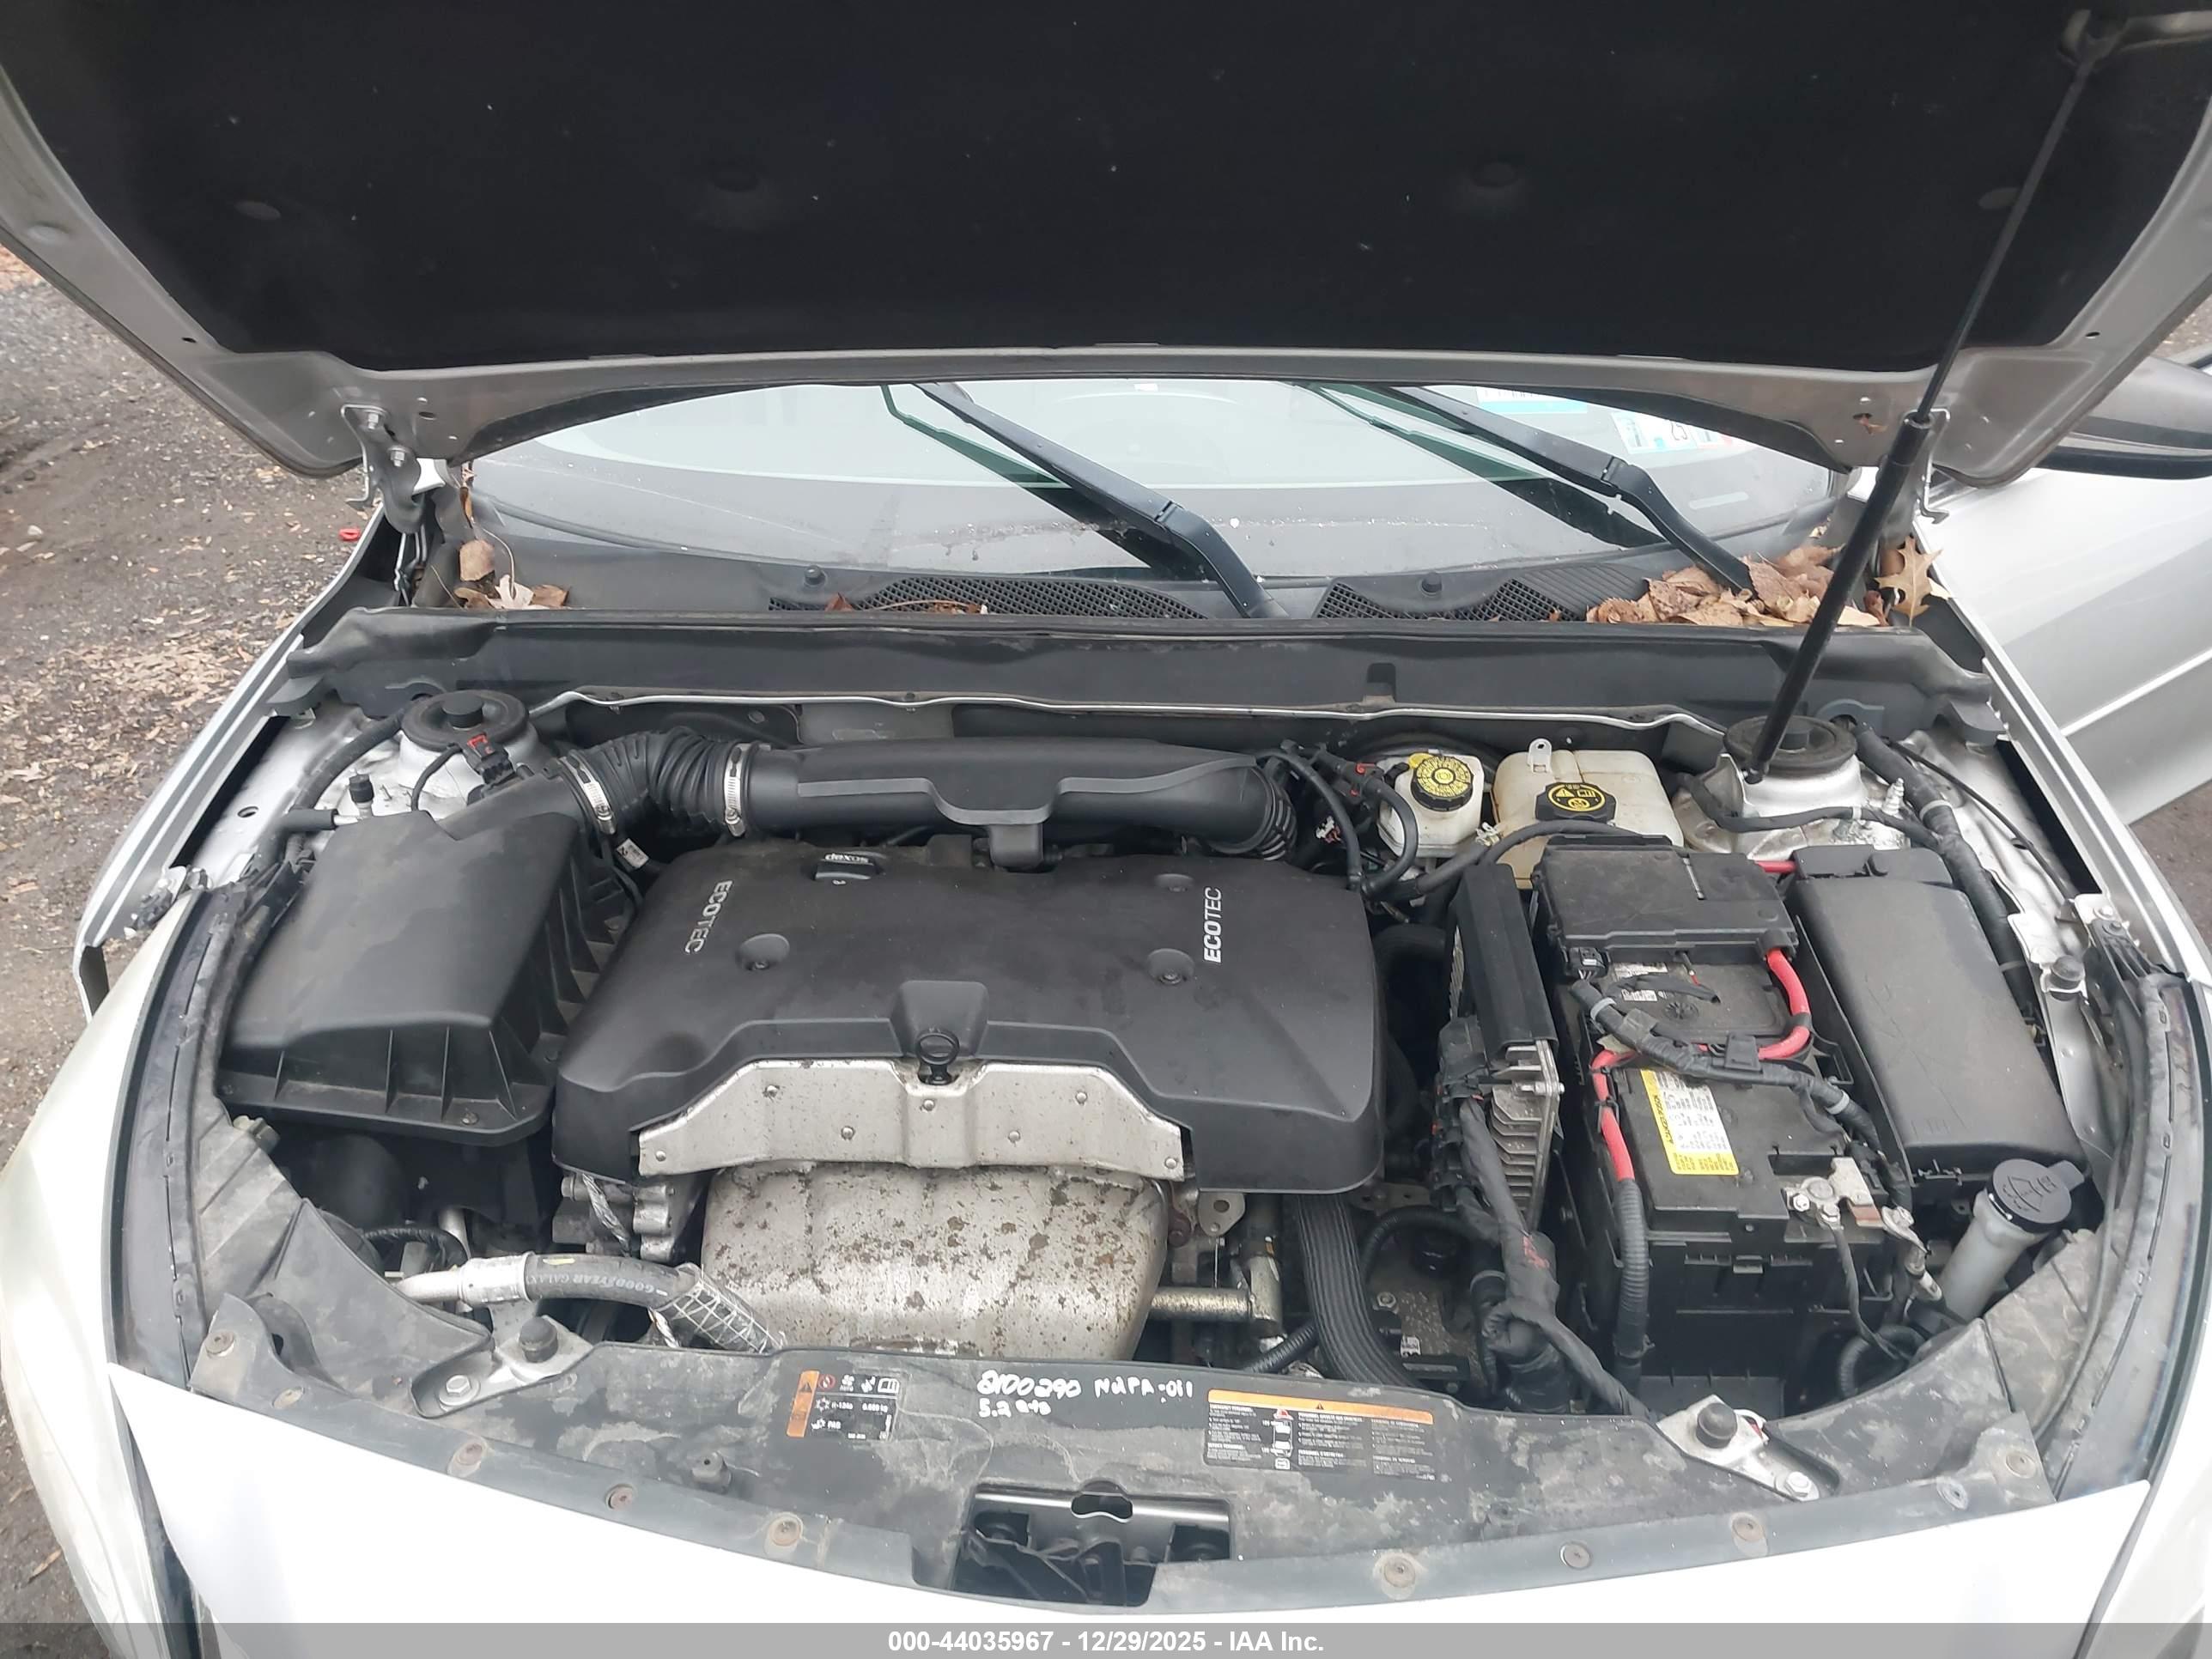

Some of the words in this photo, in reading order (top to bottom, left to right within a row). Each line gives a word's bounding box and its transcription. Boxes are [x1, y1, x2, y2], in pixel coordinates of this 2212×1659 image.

[824, 853, 869, 864] dexos
[685, 879, 732, 955] ECOTEC
[1203, 886, 1222, 963] ECOTEC
[572, 1273, 655, 1293] GOODYEAR
